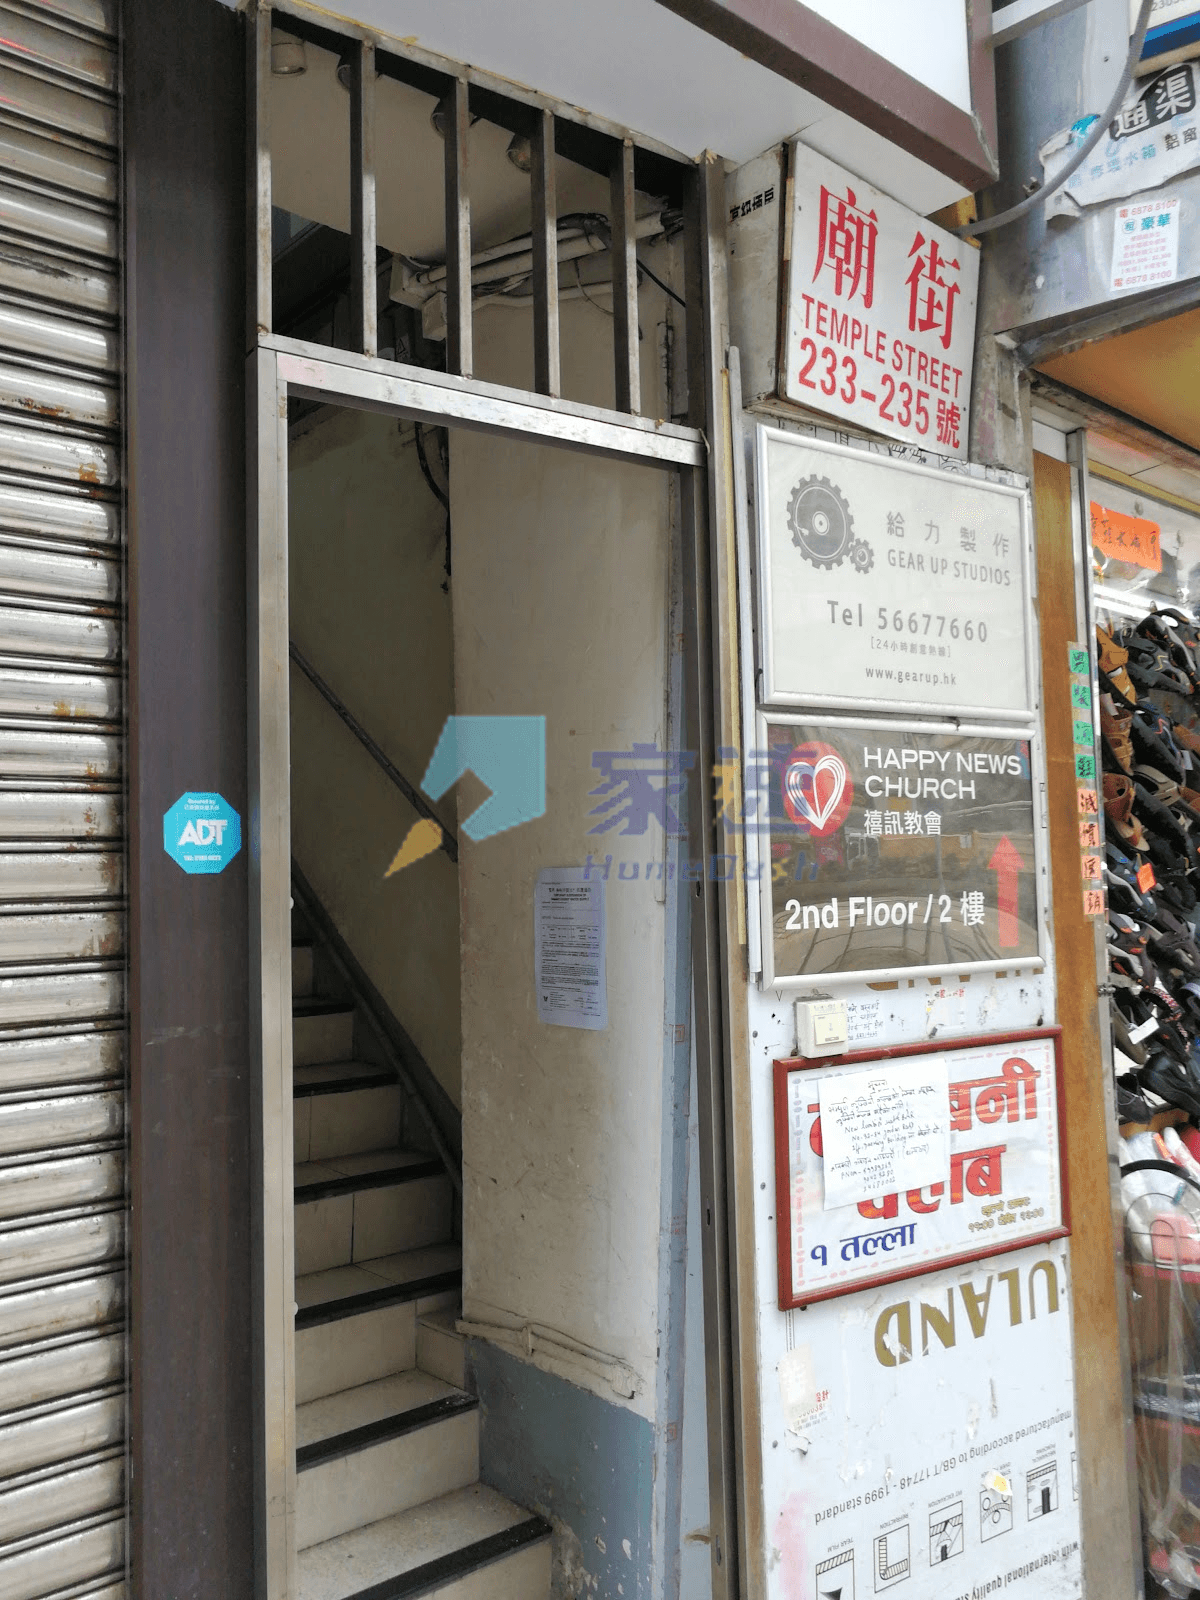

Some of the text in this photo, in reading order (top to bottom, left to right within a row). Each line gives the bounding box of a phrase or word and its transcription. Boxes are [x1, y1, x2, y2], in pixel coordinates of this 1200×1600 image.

[1115, 71, 1191, 137] 通渠
[812, 185, 961, 349] 廟街
[801, 293, 963, 396] TEMPLE STREET
[886, 511, 1010, 558] 給力製作
[887, 549, 1011, 586] GEAR UP STUDIOS
[827, 600, 988, 643] Tel 56677660
[865, 667, 956, 686] www.gearup.hk
[864, 747, 1022, 775] HAPPY NEWS
[864, 776, 976, 800] CHURCH
[178, 818, 228, 845] ADT
[864, 810, 941, 835] 禧訊教會
[785, 898, 838, 930] 2nd
[849, 897, 918, 928] Floor
[960, 891, 986, 926] 樓
[840, 1223, 917, 1261] तल्ला
[874, 1259, 1059, 1367] ULAND
[1016, 1410, 1072, 1440] manufactured
[959, 1451, 968, 1463] to
[969, 1433, 1013, 1458] according
[900, 1468, 929, 1490] 17748
[933, 1457, 957, 1476] GB/T
[865, 1484, 890, 1505] 1999
[815, 1496, 862, 1525] standard
[972, 1575, 1001, 1600] quality
